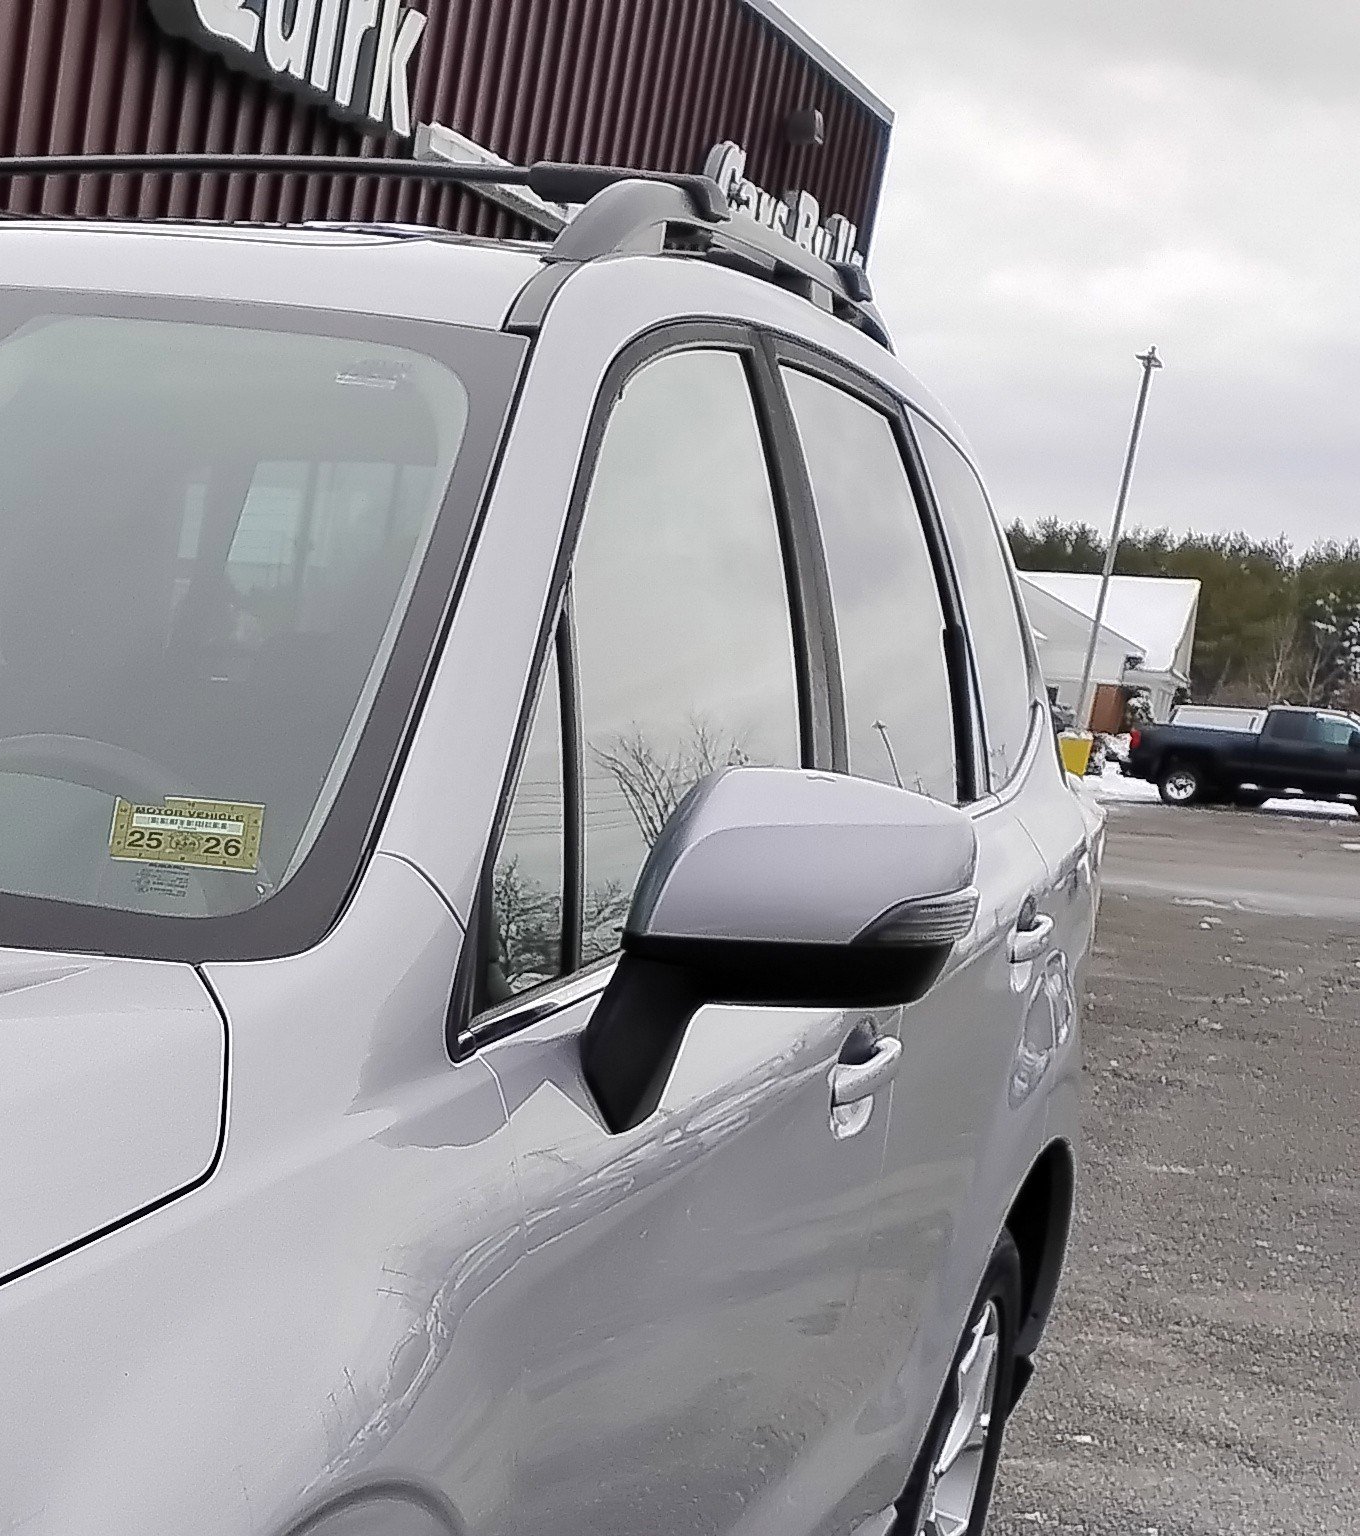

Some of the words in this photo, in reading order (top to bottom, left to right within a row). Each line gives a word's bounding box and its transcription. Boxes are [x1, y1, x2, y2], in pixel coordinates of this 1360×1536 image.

[194, 0, 427, 138] uirk
[135, 806, 183, 817] MOTOR
[188, 810, 244, 821] VEHICLE
[127, 830, 163, 850] 25
[203, 836, 242, 857] 26
